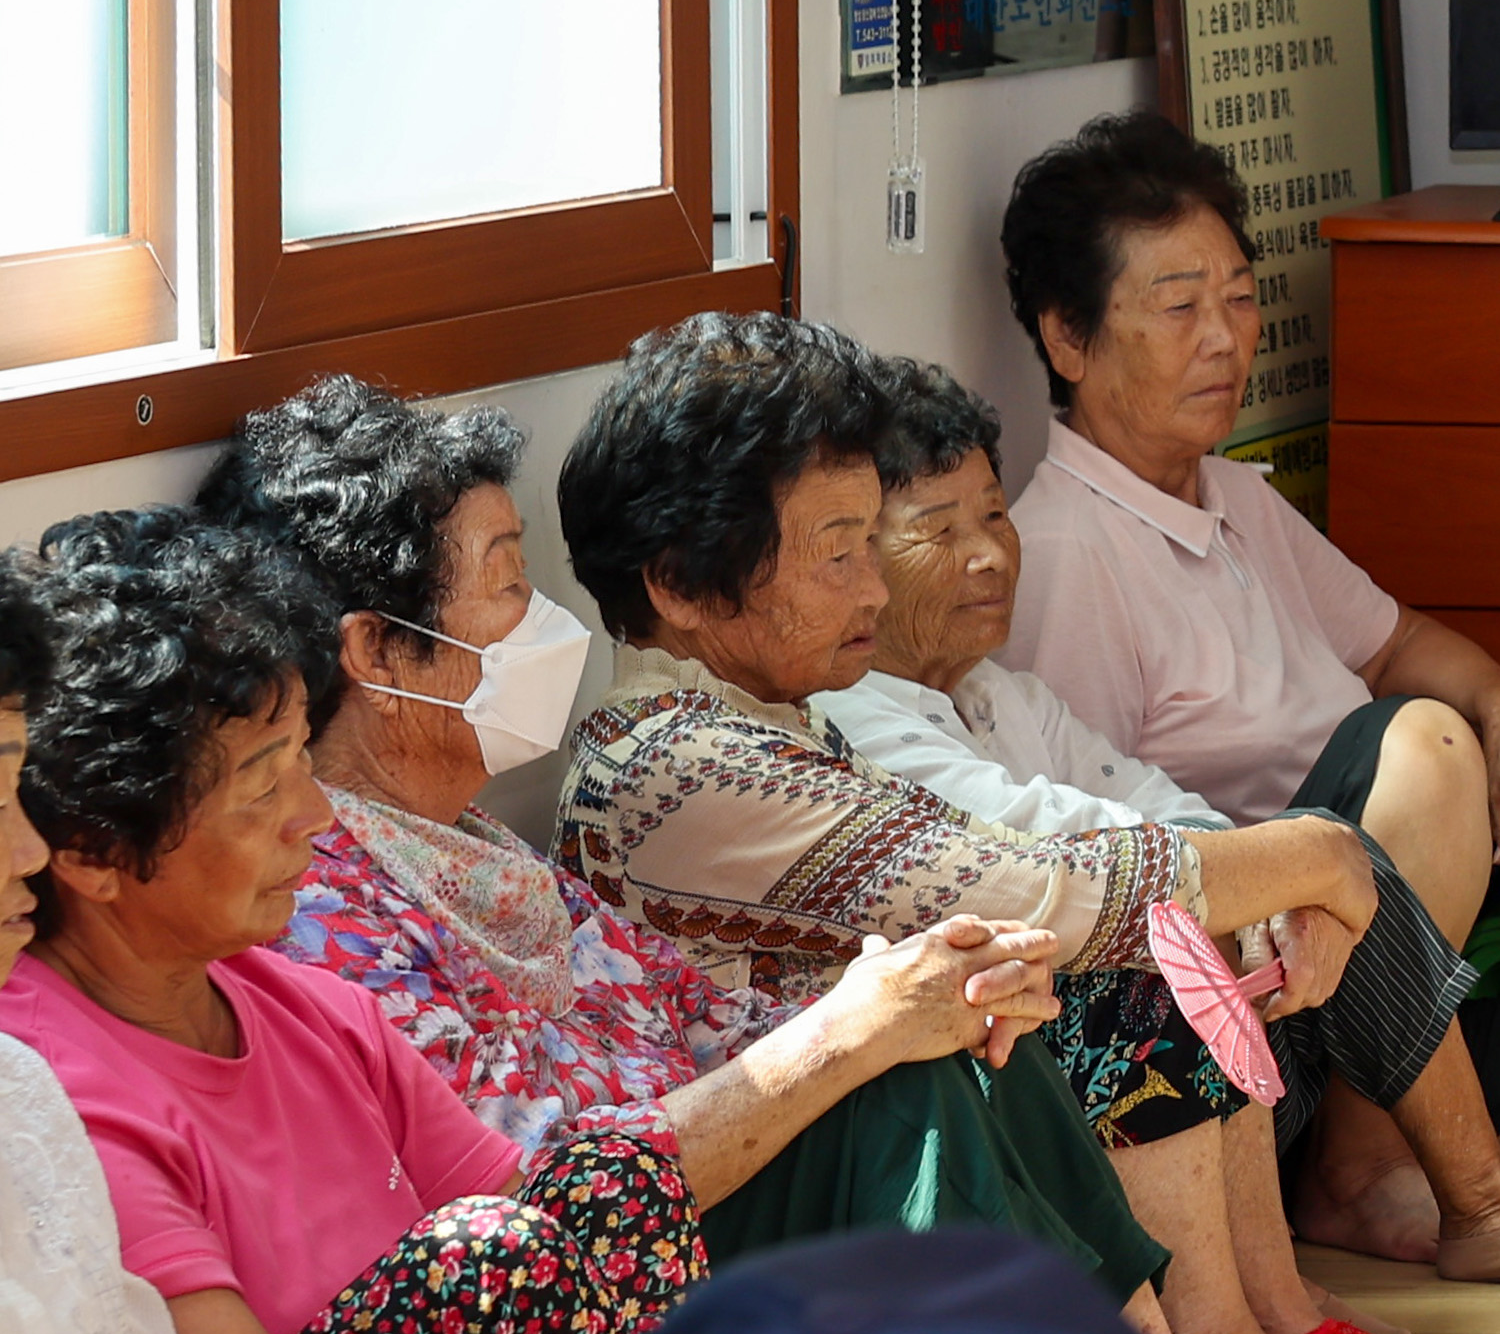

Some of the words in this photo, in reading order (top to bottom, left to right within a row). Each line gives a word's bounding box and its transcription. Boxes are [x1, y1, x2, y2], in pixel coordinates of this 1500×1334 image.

[1209, 2, 1228, 35] 손을
[1231, 0, 1252, 33] 많이
[1212, 46, 1251, 83] 긍정적인
[1254, 41, 1284, 77] 생각을
[1288, 39, 1309, 72] 많이
[1312, 35, 1338, 67] 하자.
[1246, 91, 1266, 124] 많이
[1240, 139, 1259, 170] 자주
[1263, 133, 1297, 166] 마시자.
[1253, 181, 1282, 217] 중독성
[1320, 169, 1357, 202] 피하자.
